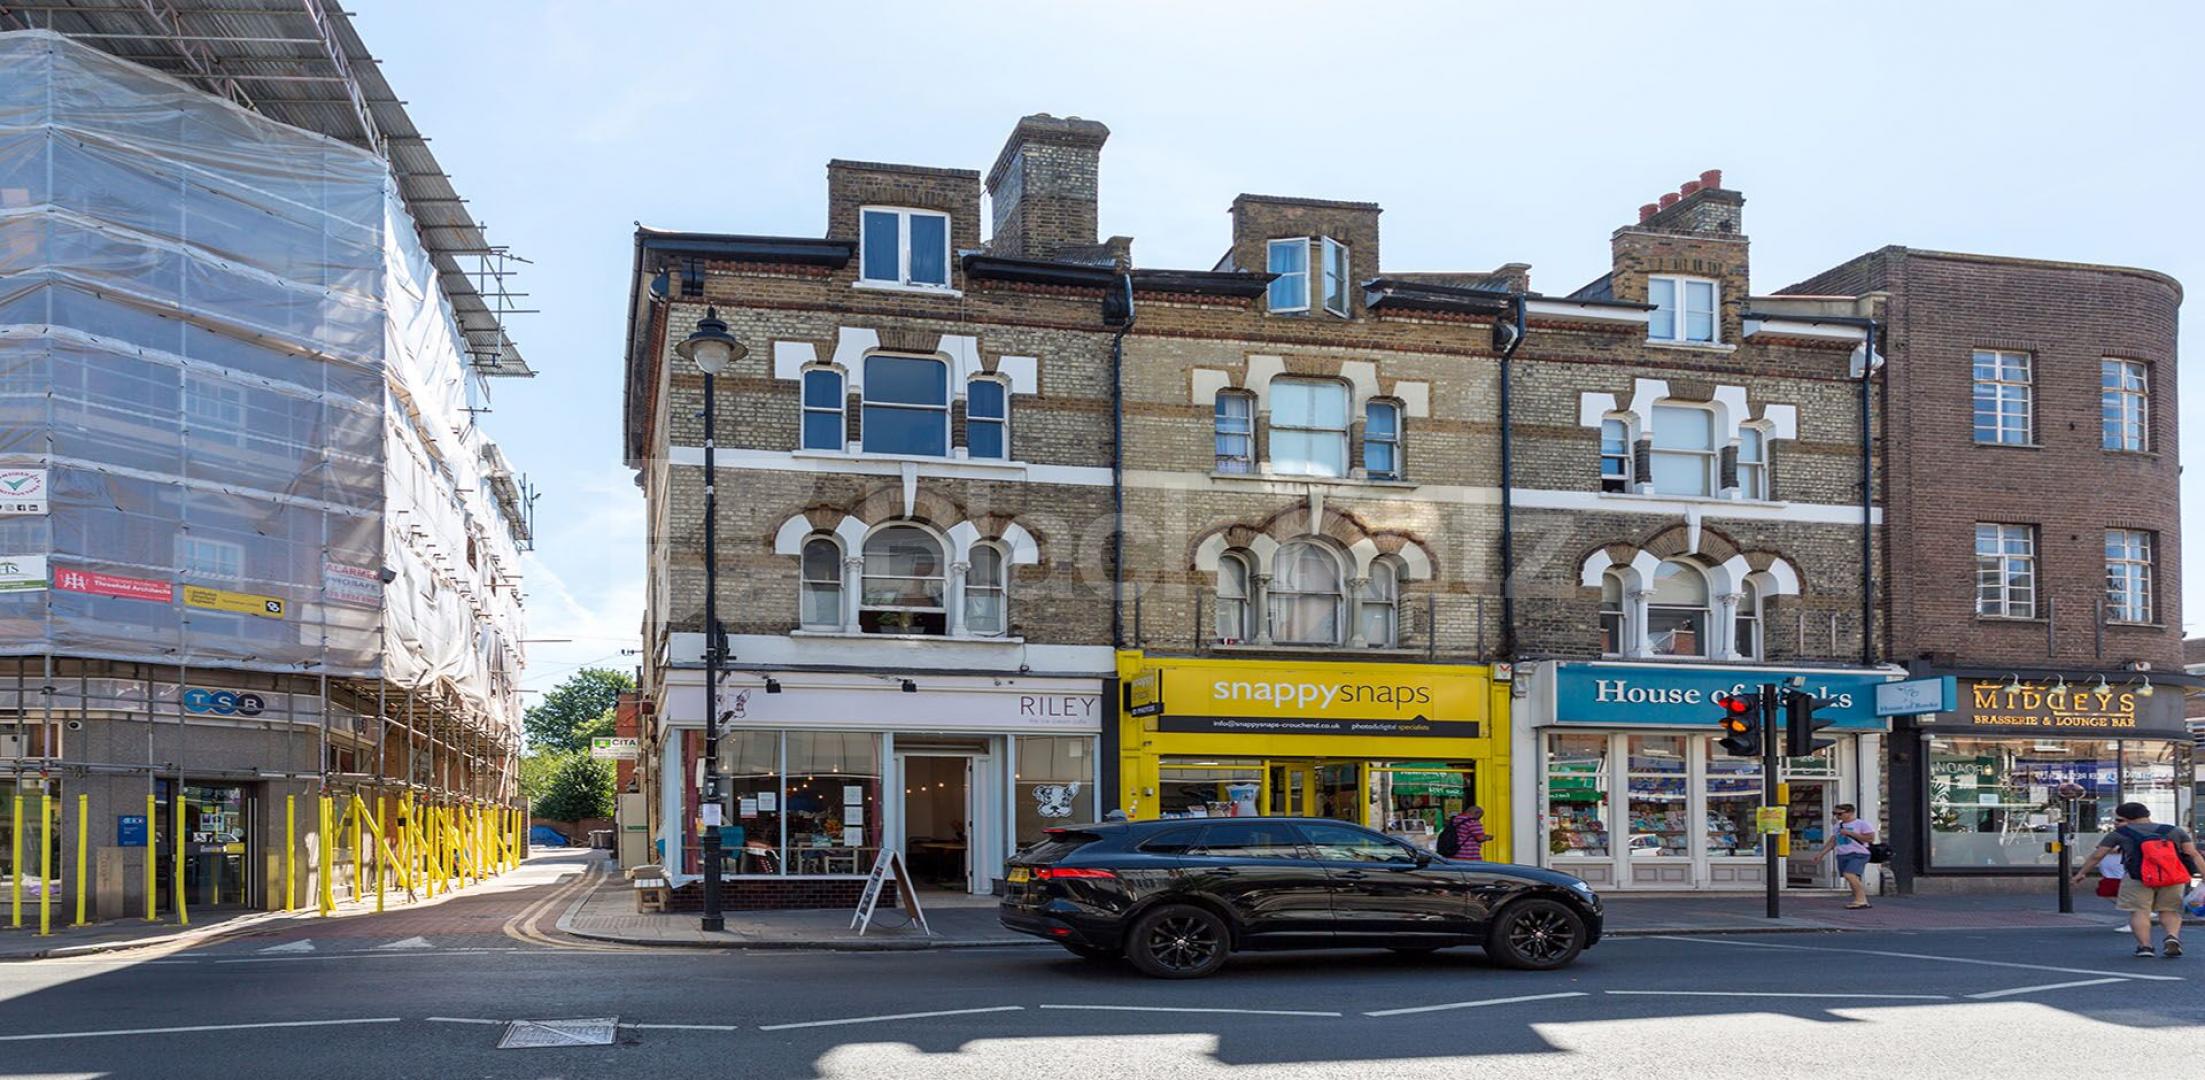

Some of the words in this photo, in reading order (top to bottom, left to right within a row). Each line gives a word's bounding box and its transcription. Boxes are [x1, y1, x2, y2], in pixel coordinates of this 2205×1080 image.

[1595, 678, 1700, 703] House
[1020, 695, 1096, 717] RILEY
[1973, 714, 2038, 727] BRASSERIE
[2042, 716, 2051, 726] &
[2056, 716, 2108, 727] LOUNGE
[2111, 717, 2136, 728] BAR
